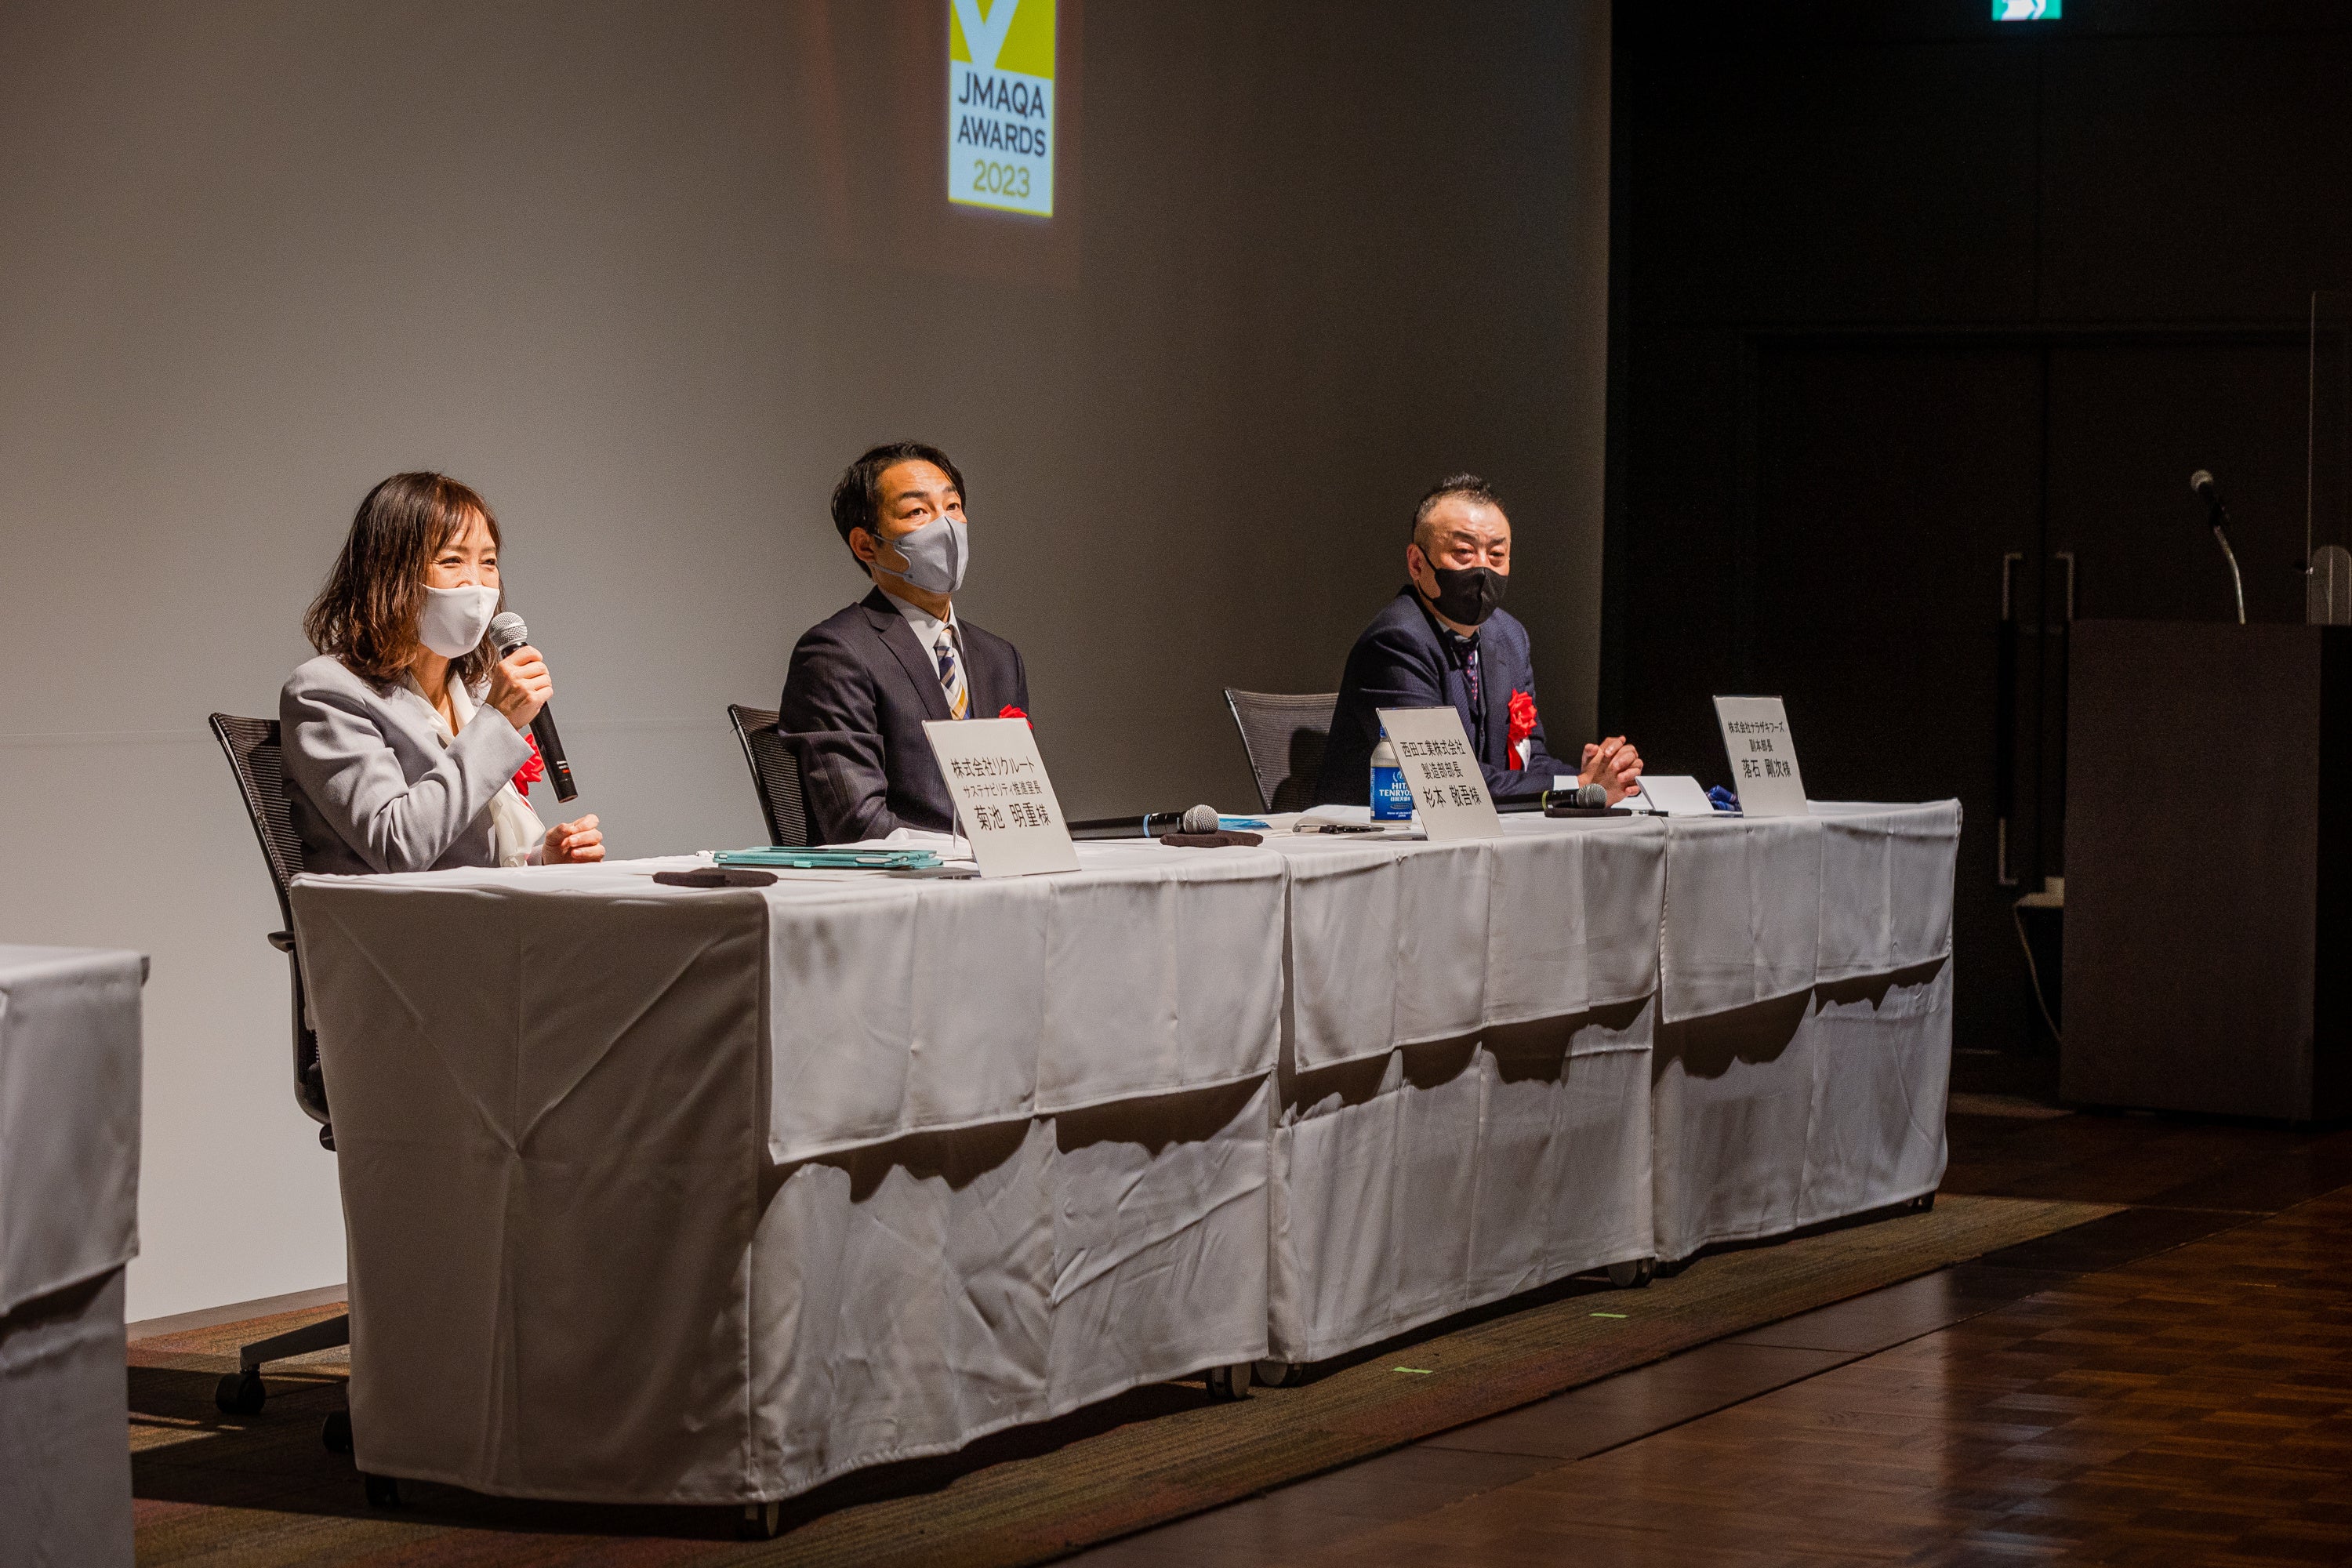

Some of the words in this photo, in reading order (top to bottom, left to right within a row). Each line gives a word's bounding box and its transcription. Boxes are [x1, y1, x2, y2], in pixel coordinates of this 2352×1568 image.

[958, 71, 1045, 118] JMAQA
[957, 115, 1046, 157] AWARDS
[973, 159, 1030, 198] 2023
[1400, 739, 1466, 757] 西田工業株式会社
[951, 756, 1035, 779] 株式会社リクルート
[1421, 761, 1464, 779] 製造部部長
[1741, 758, 1761, 778] 落石
[963, 780, 1043, 798] サステナビリティ推進室長
[1423, 786, 1446, 809] 杉本
[1449, 785, 1482, 807] 敬吾様
[974, 805, 1006, 830] 菊池
[1009, 802, 1051, 827] 明重様
